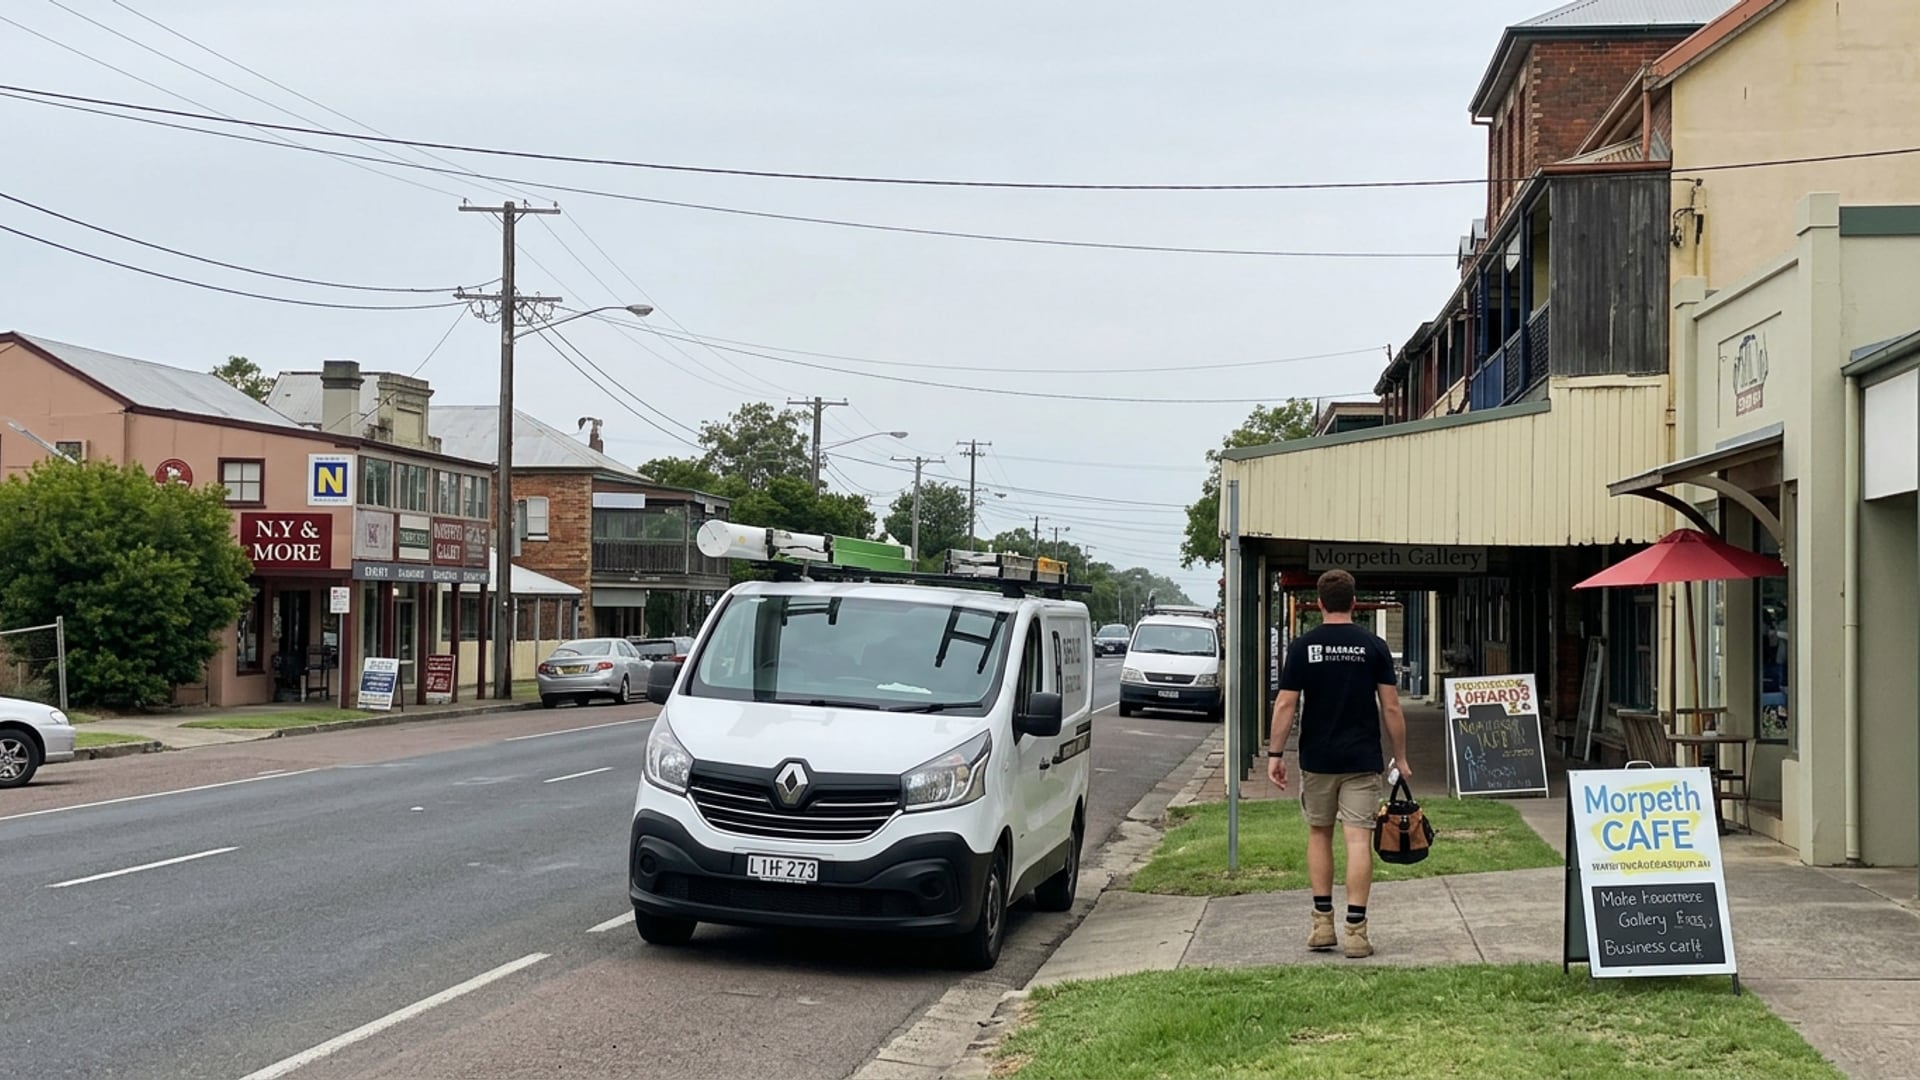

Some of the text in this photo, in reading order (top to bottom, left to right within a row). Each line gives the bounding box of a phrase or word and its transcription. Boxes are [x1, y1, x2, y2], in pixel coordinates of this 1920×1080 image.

[318, 466, 344, 494] N
[300, 520, 320, 538] &
[253, 543, 321, 561] MORE
[1315, 548, 1482, 570] Morpeth Gallery
[1584, 781, 1701, 820] Morpeth
[1602, 820, 1694, 851] CAFE
[786, 861, 816, 879] 273
[1601, 891, 1637, 907] Make
[1604, 939, 1666, 956] Business
